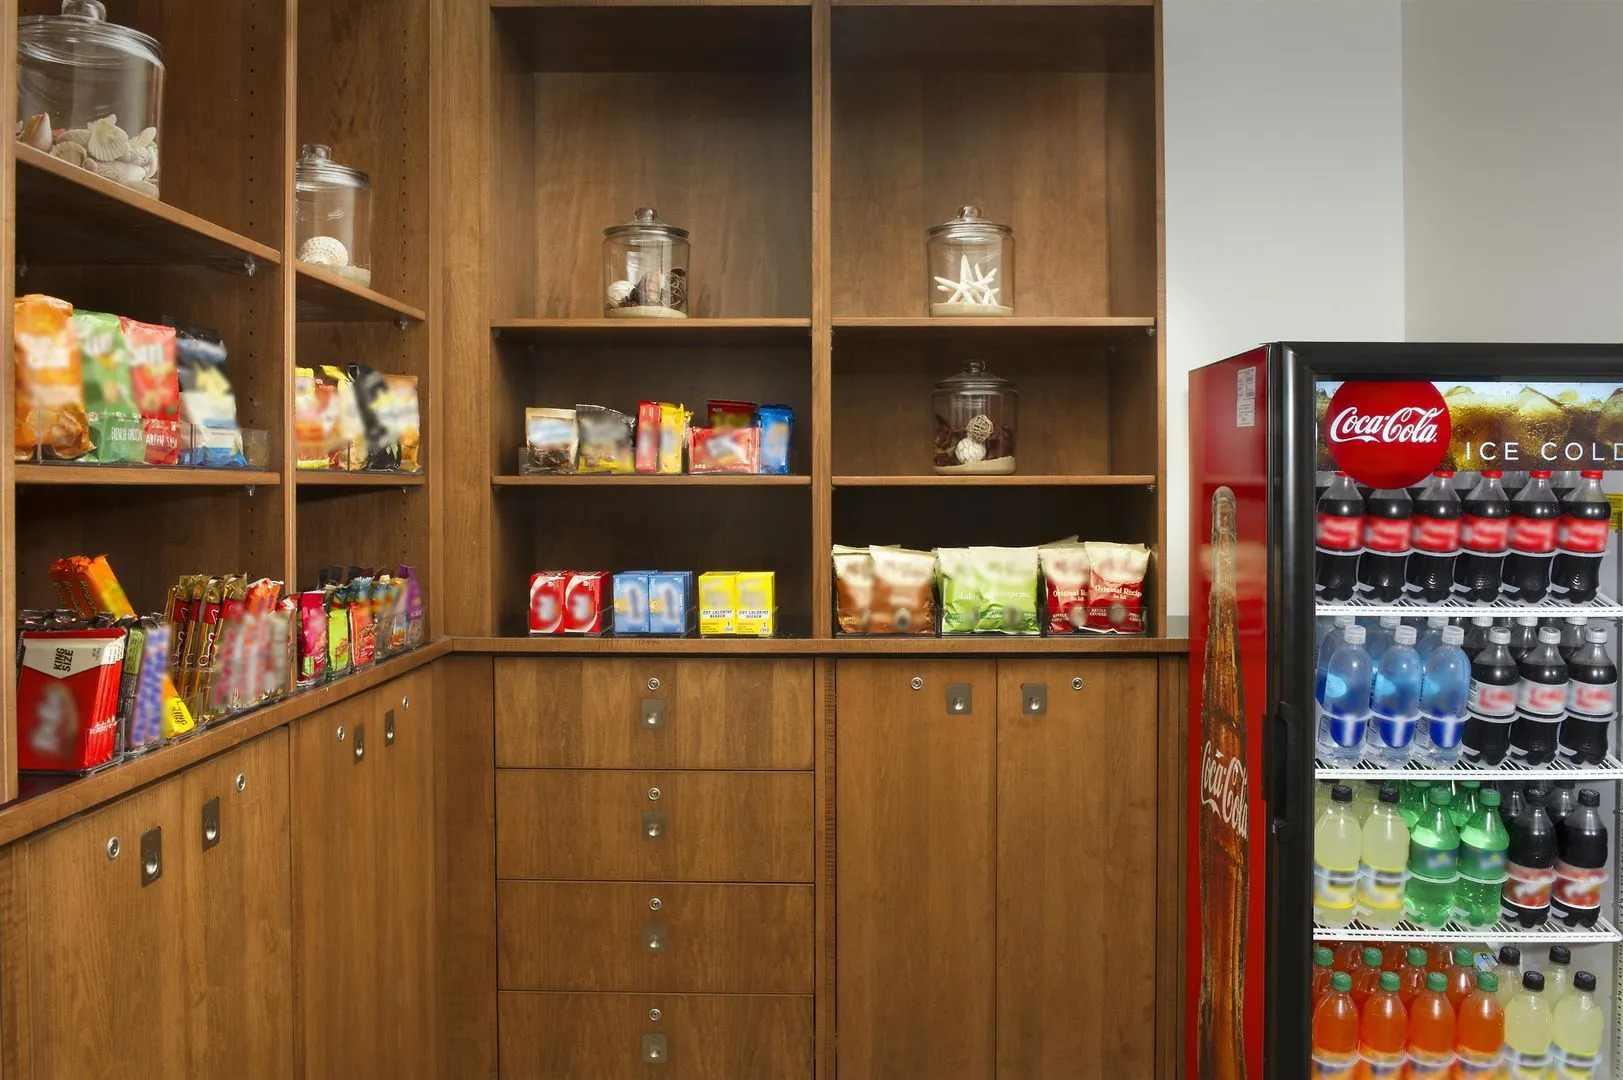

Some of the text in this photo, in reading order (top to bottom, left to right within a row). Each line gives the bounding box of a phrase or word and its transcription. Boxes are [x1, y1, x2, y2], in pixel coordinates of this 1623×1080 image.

[1329, 406, 1445, 444] Coca-Cola
[1466, 441, 1519, 461] ICE
[1094, 584, 1122, 594] Original
[1123, 588, 1142, 598] Recip
[53, 647, 65, 671] KING
[62, 648, 74, 672] SIZE
[1200, 740, 1249, 841] Coca-Cola
